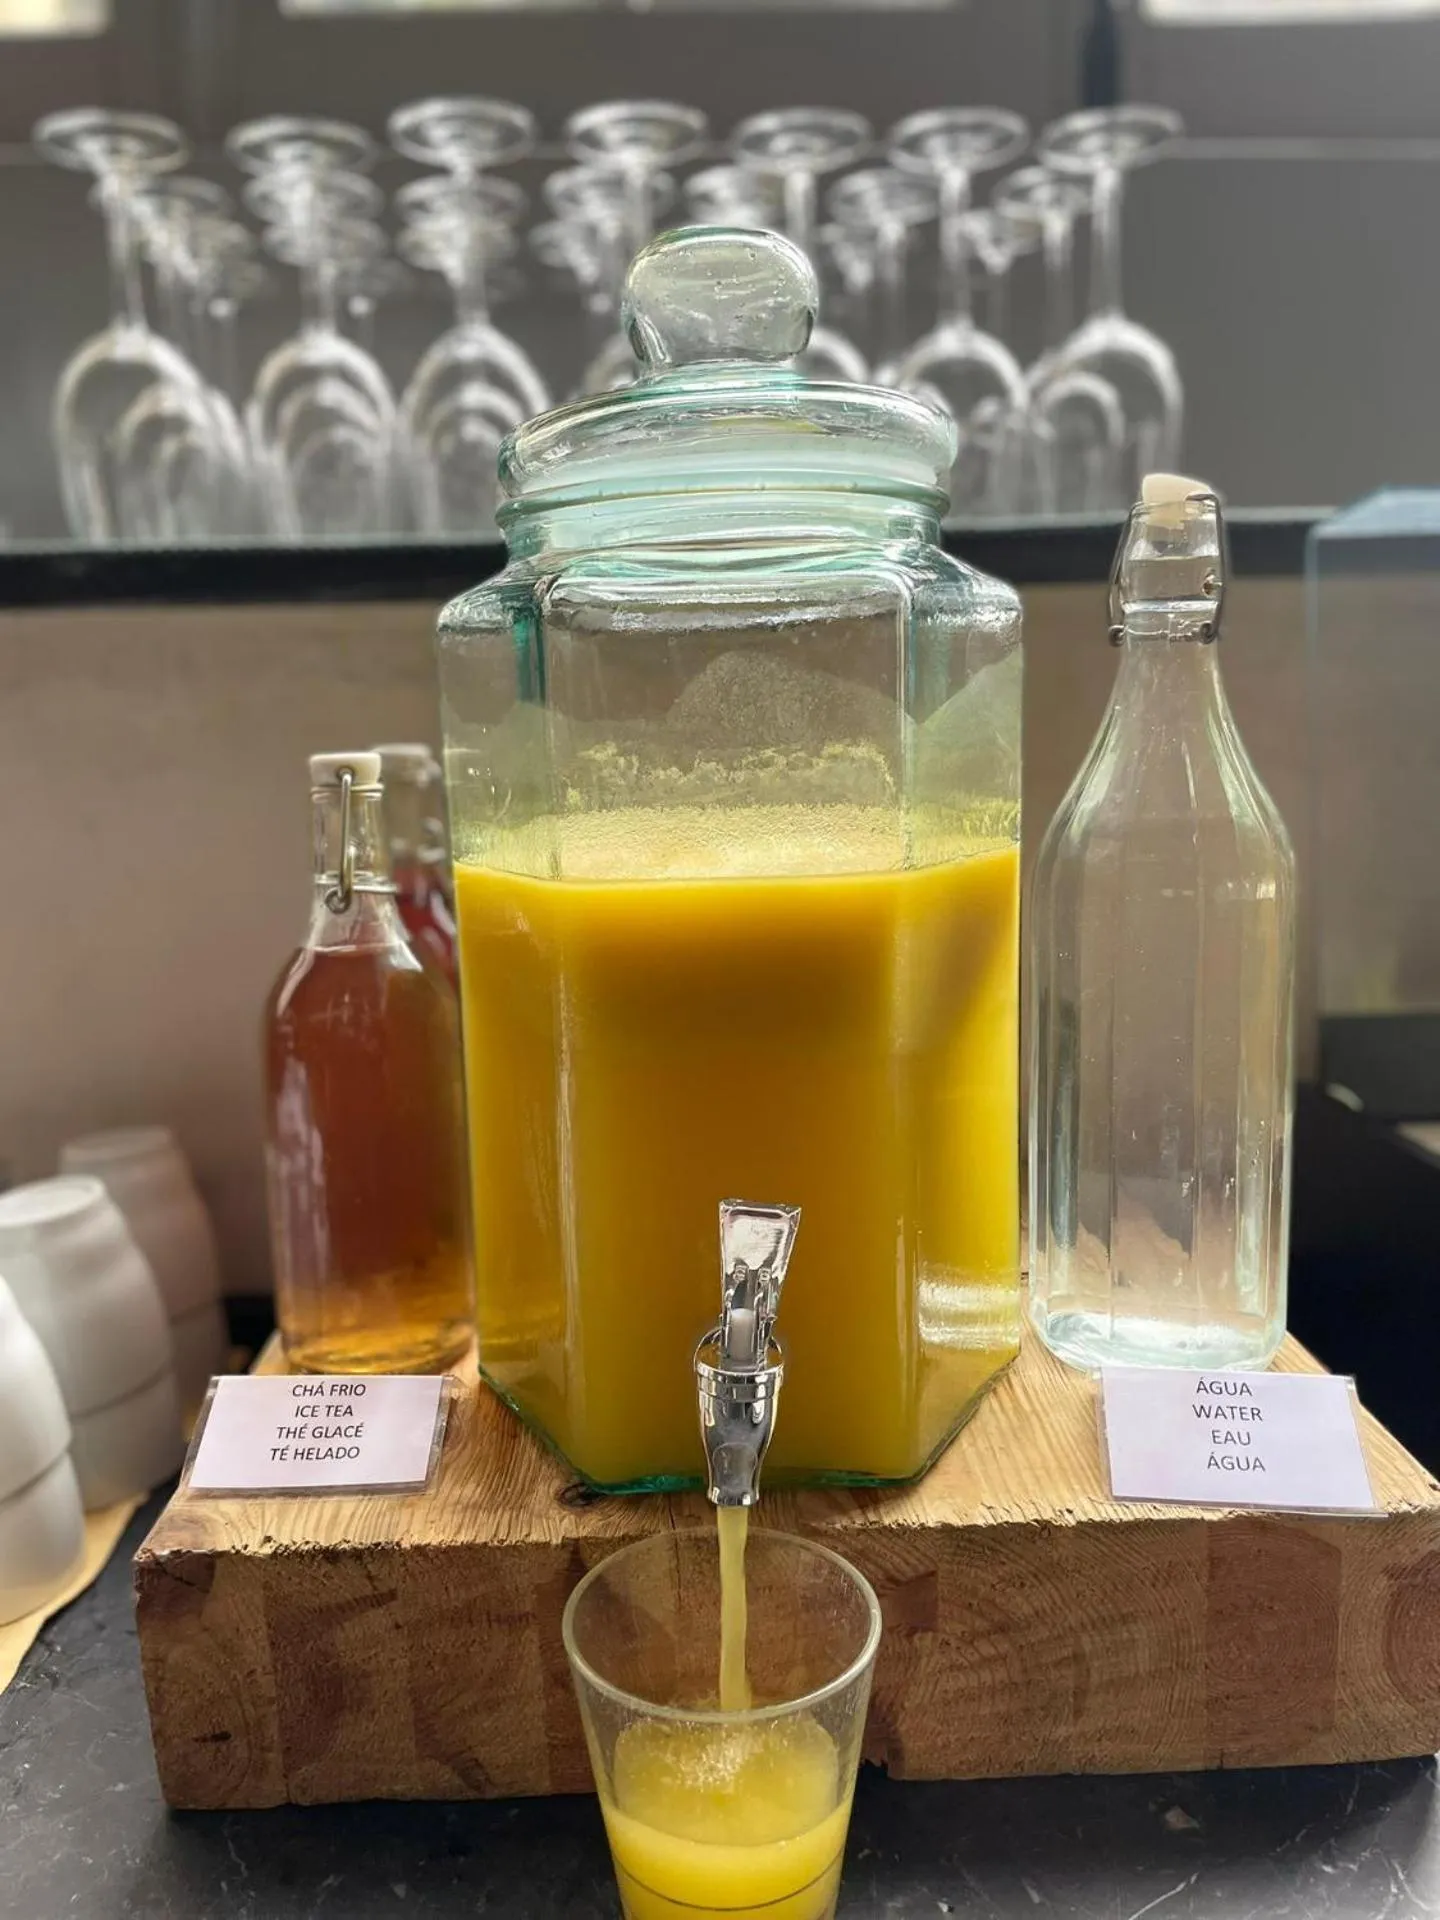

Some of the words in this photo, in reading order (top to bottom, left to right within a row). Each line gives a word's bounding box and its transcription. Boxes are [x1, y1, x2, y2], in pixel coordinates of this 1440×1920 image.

[292, 1381, 325, 1397] CHÁ
[330, 1383, 366, 1396] FRIO
[1196, 1376, 1253, 1396] ÁGUA
[294, 1404, 319, 1418] ICE
[325, 1404, 354, 1417] TEA
[1192, 1404, 1264, 1421] WATER
[276, 1423, 307, 1439] THÉ
[312, 1422, 364, 1439] GLACÉ
[1212, 1429, 1252, 1446] EAU
[270, 1445, 289, 1461] TÉ
[293, 1446, 360, 1460] HELADO
[1207, 1451, 1266, 1472] ÁGUA
